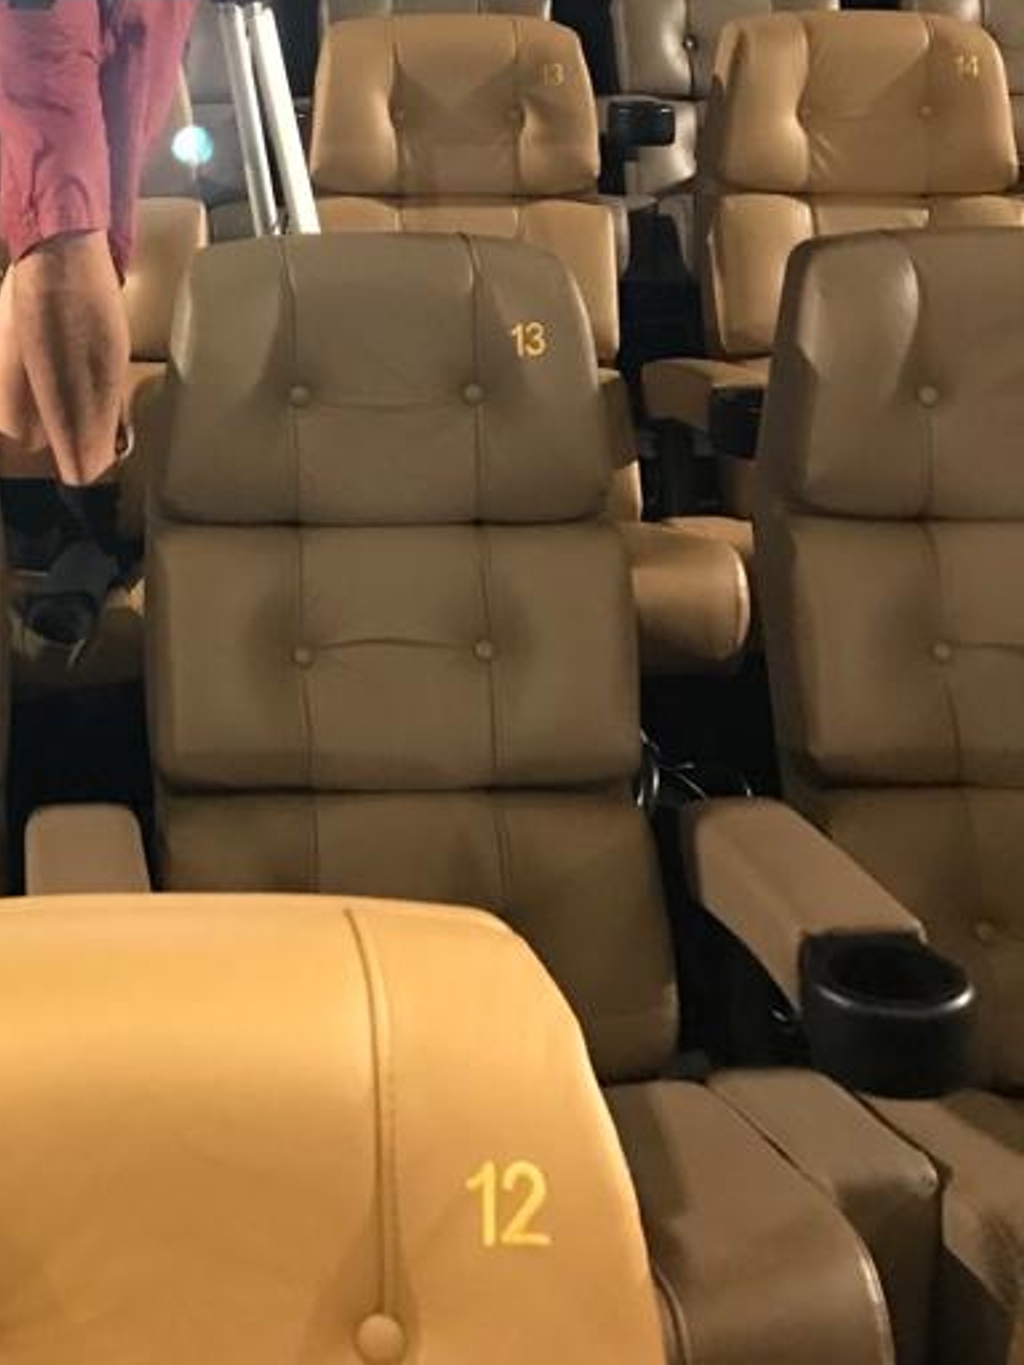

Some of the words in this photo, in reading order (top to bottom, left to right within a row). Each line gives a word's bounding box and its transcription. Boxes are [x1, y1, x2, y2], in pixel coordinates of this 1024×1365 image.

[542, 62, 565, 86] 13
[956, 54, 979, 77] 14
[510, 321, 547, 358] 13
[464, 1158, 552, 1249] 12
